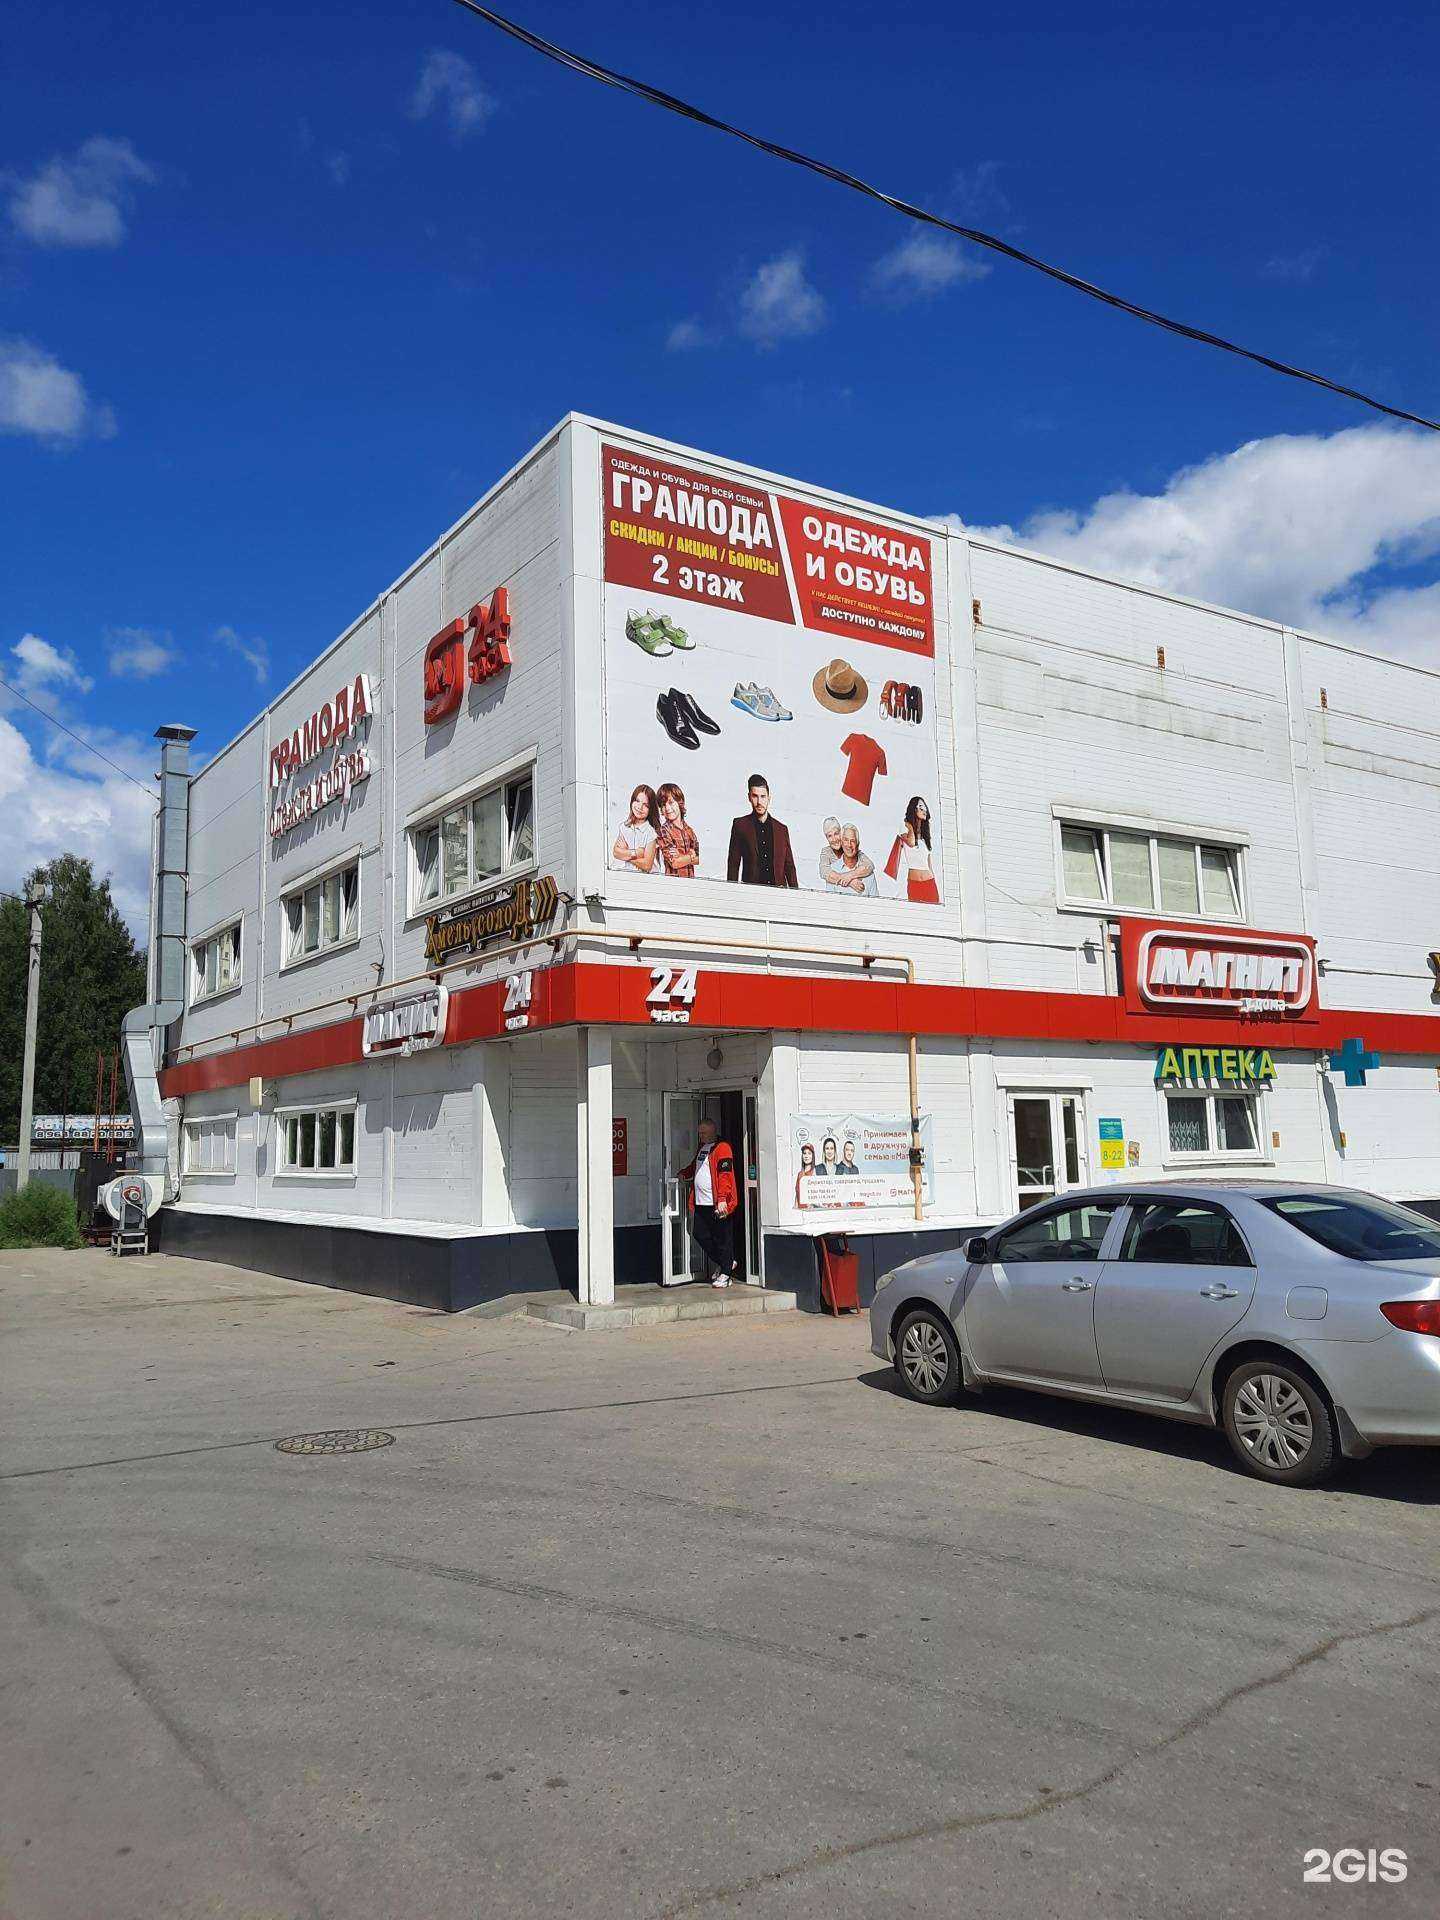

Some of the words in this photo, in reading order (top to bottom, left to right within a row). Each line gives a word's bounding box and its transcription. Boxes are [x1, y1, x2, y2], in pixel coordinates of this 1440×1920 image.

[611, 458, 651, 476] ОДЕЖДА
[652, 470, 659, 478] И
[661, 472, 690, 487] ОБУВЬ
[692, 481, 710, 494] ДЛЯ
[711, 487, 734, 500] ВСЕЙ
[736, 494, 764, 509] СЕМЬИ
[611, 471, 774, 550] ГРАМОДА
[610, 519, 666, 549] СКИДКИ
[676, 538, 718, 562] АКЦИИ
[728, 553, 780, 578] БОНУСЫ
[802, 516, 926, 572] ОДЕЖДА
[652, 554, 670, 585] 2
[679, 565, 745, 603] этаж
[806, 552, 826, 581] И
[834, 561, 926, 606] ОБУВЬ
[821, 606, 876, 627] ДОСТУПНО
[878, 620, 926, 640] КАЖДОМУ
[270, 673, 373, 788] ГРАМОДА
[503, 971, 533, 1013] 24
[646, 966, 699, 1005] 24
[1149, 947, 1303, 993] МАГНИТ
[651, 1009, 690, 1024] часа
[1161, 1047, 1278, 1080] АПТЕКА
[863, 1129, 908, 1140] Принимаем
[870, 1142, 907, 1151] дружную
[897, 1188, 918, 1197] МАГН
